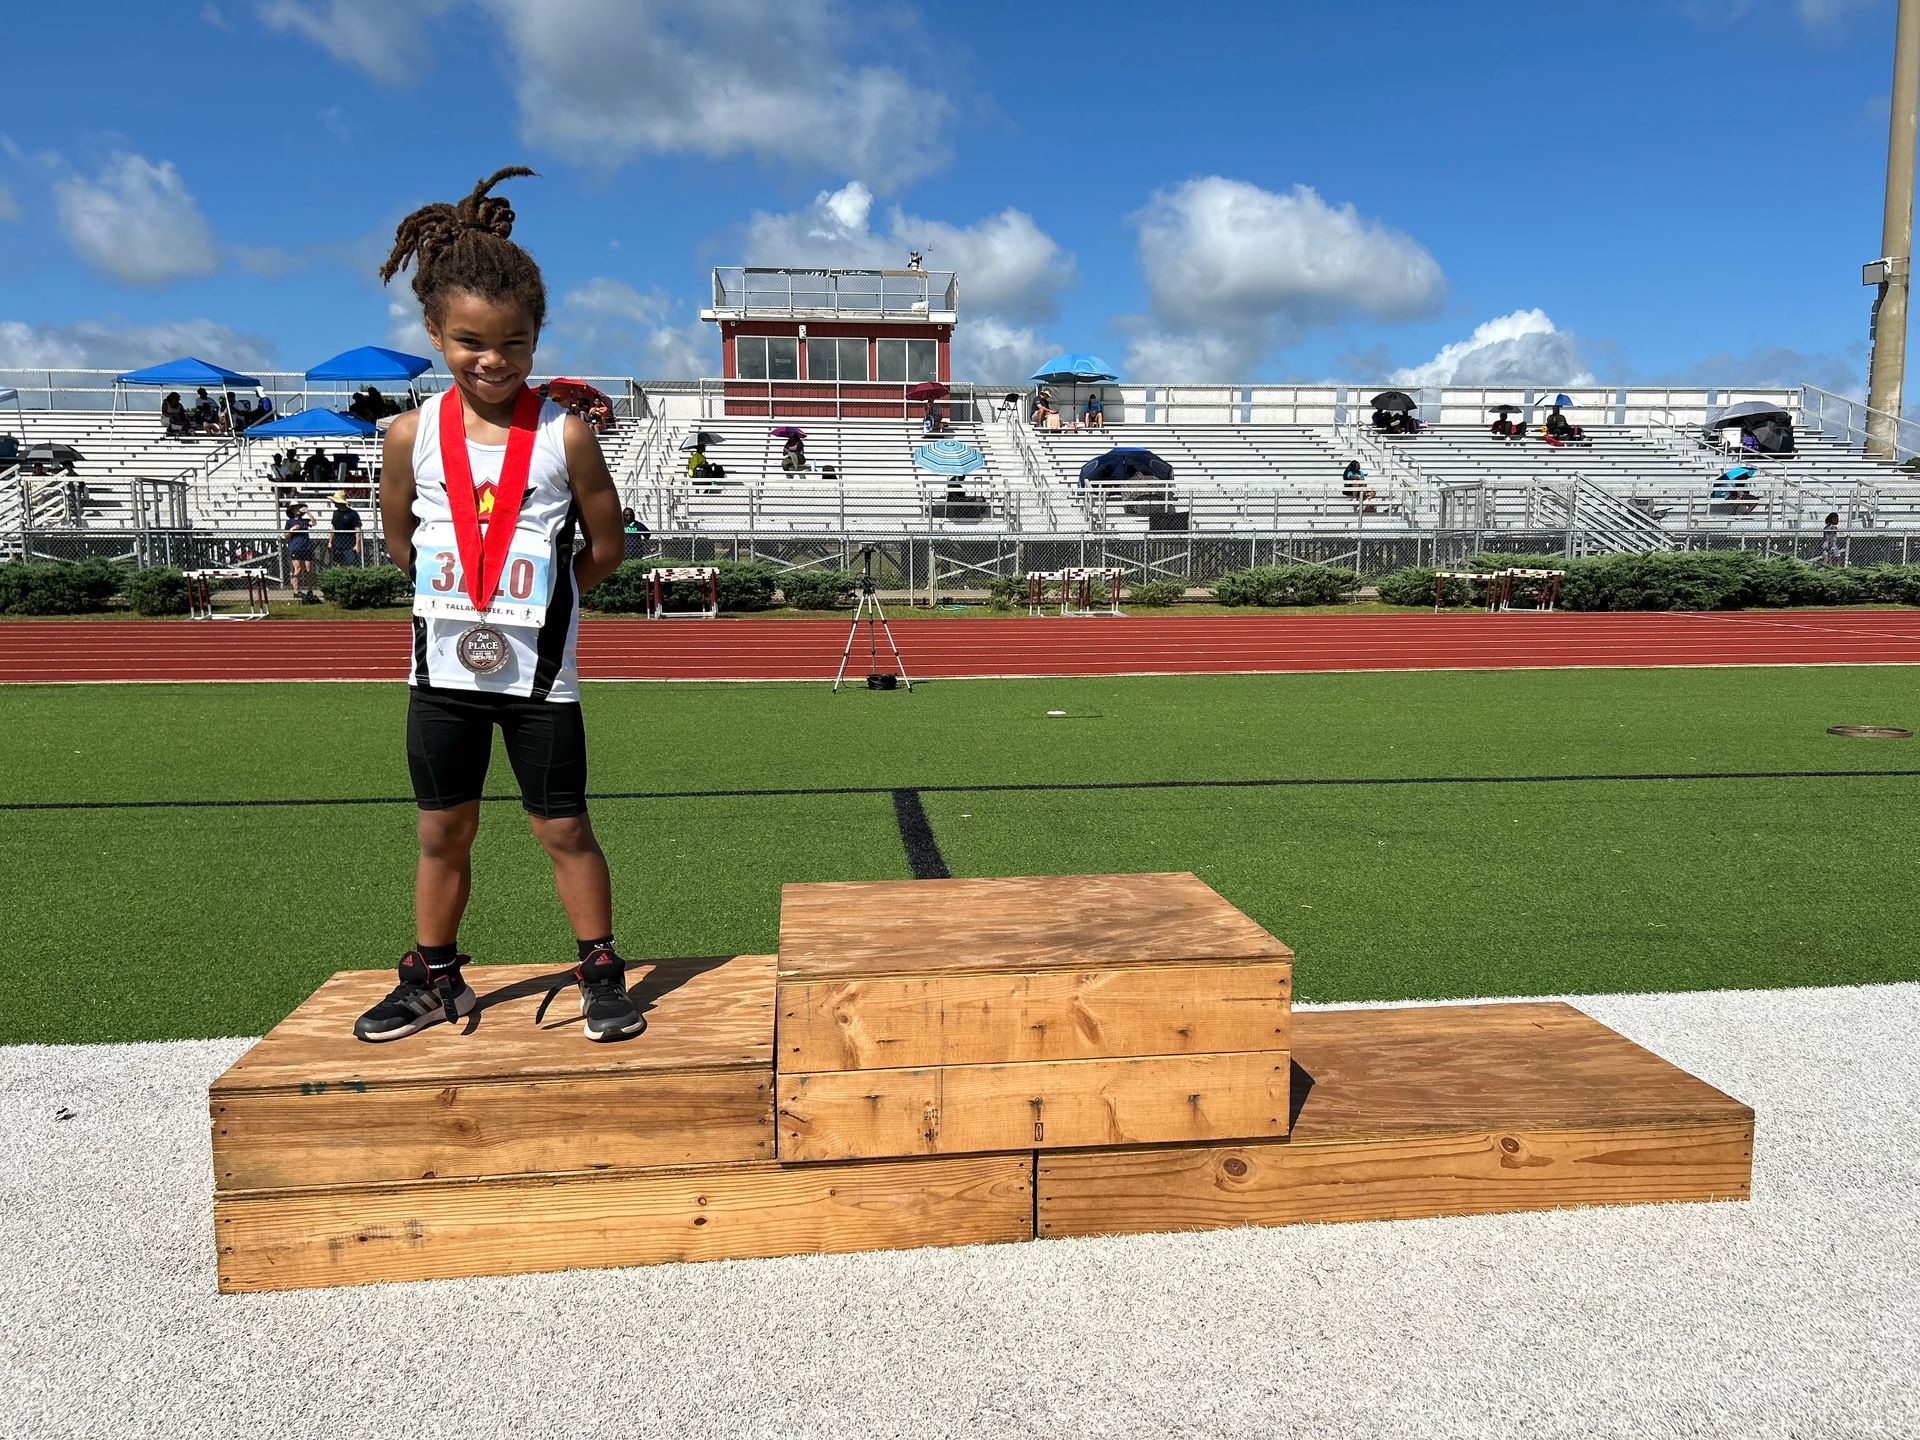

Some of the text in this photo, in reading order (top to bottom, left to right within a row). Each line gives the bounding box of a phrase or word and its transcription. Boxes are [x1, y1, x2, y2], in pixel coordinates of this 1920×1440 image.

[431, 551, 535, 600] 30
[445, 603, 503, 615] TALLAHSEE,
[476, 632, 489, 642] 2nd
[468, 641, 499, 650] PLACE
